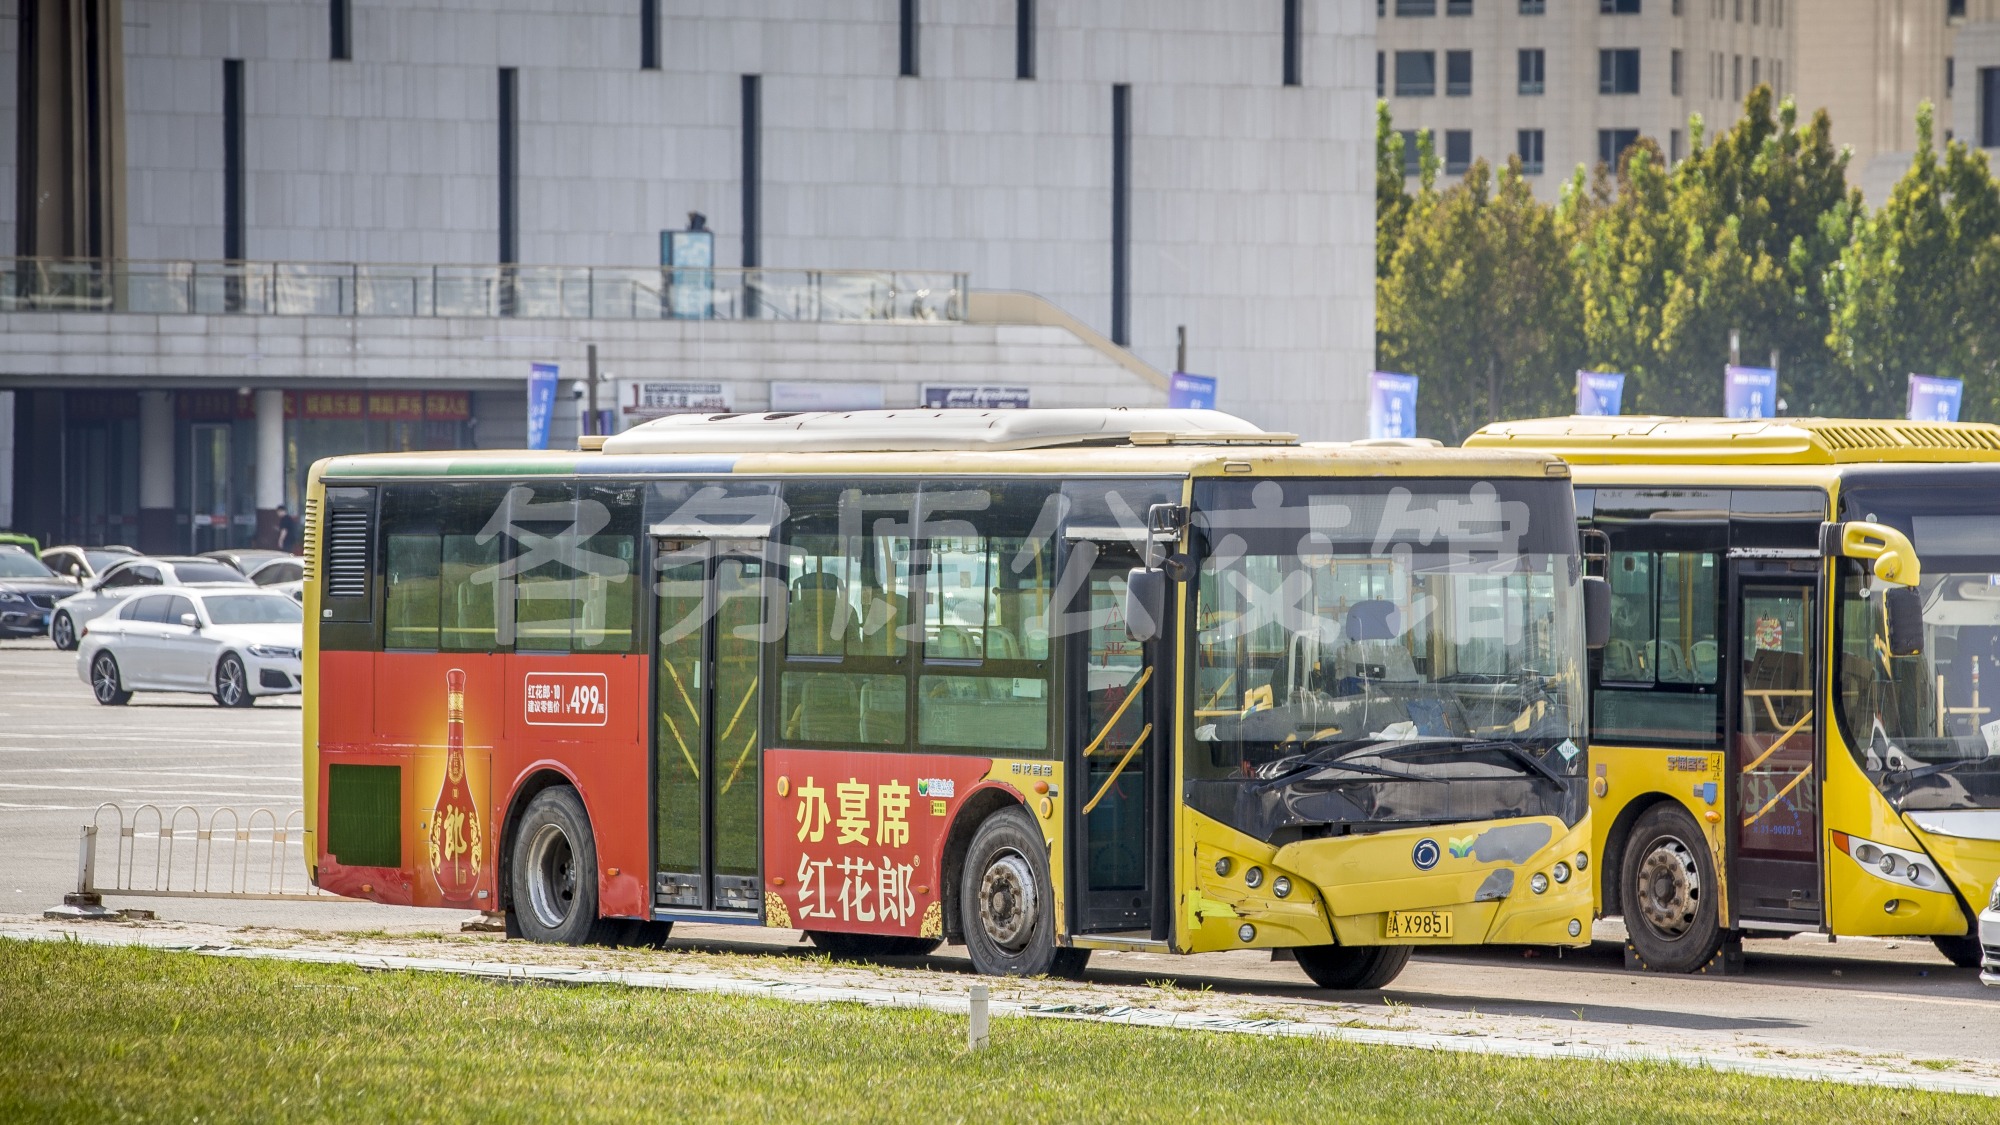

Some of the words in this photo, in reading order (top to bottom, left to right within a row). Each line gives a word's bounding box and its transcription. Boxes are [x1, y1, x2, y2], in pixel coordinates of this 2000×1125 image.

[527, 700, 560, 713] 建议零售价
[1561, 744, 1575, 754] LNG
[1011, 763, 1052, 776] 申龙客车
[1667, 755, 1708, 772] 宇通客车
[796, 776, 911, 848] 办宴席
[797, 852, 916, 927] 红花郎
